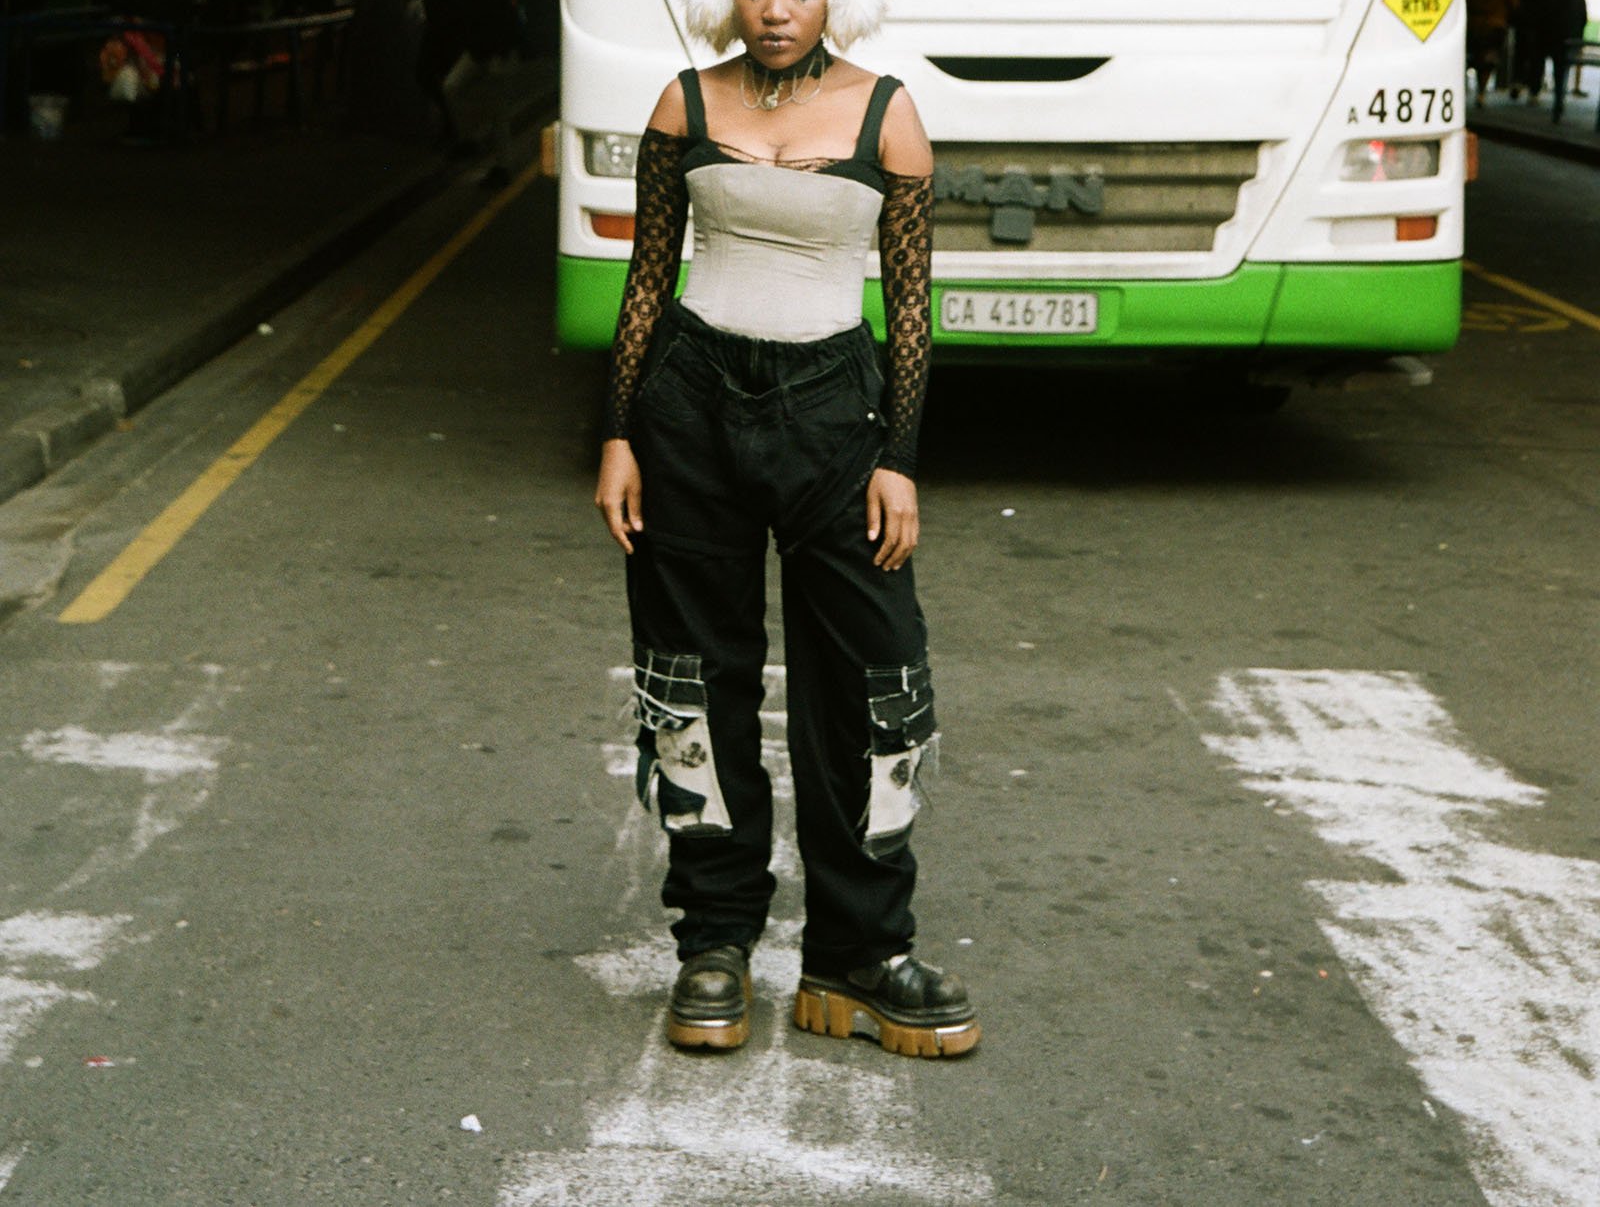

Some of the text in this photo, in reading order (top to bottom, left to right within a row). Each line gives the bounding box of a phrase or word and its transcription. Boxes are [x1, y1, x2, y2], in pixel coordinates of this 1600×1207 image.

[1347, 89, 1454, 124] A 4878
[932, 163, 1104, 214] MAN
[946, 297, 976, 325] CA
